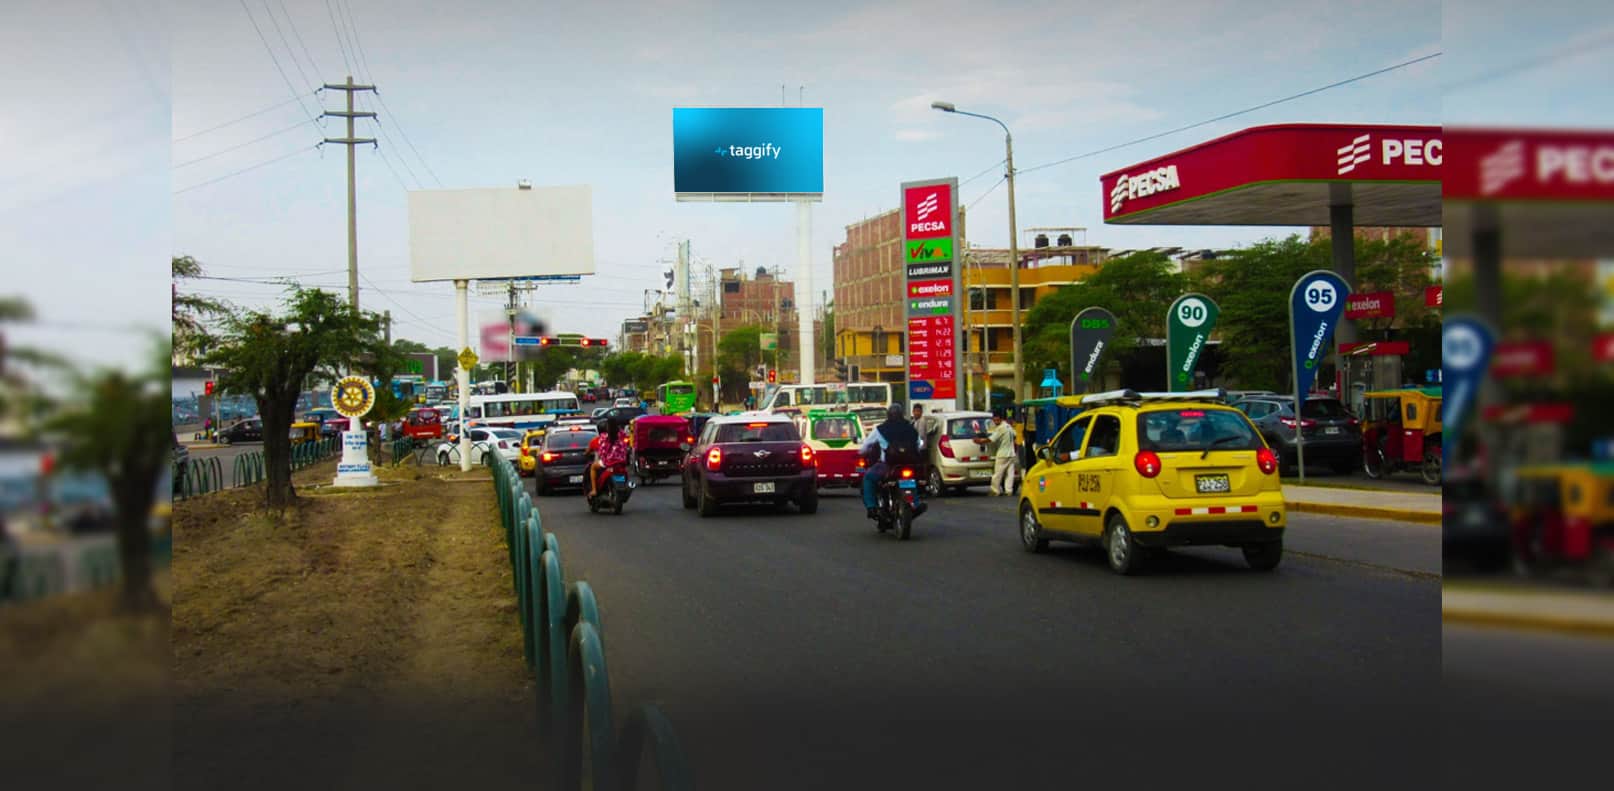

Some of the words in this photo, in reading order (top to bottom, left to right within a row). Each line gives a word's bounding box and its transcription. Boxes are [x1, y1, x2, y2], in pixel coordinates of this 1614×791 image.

[729, 143, 781, 160] taggify
[1128, 164, 1180, 200] PECSA
[911, 221, 945, 233] PECSA
[908, 265, 949, 276] LUBRIMAX
[918, 284, 949, 294] exelon
[1308, 288, 1332, 304] 95
[918, 299, 949, 309] endura
[1351, 297, 1380, 310] exelon
[1181, 305, 1204, 320] 90
[1308, 321, 1328, 360] exelon
[1085, 340, 1105, 374] endura
[1182, 334, 1204, 372] exelon
